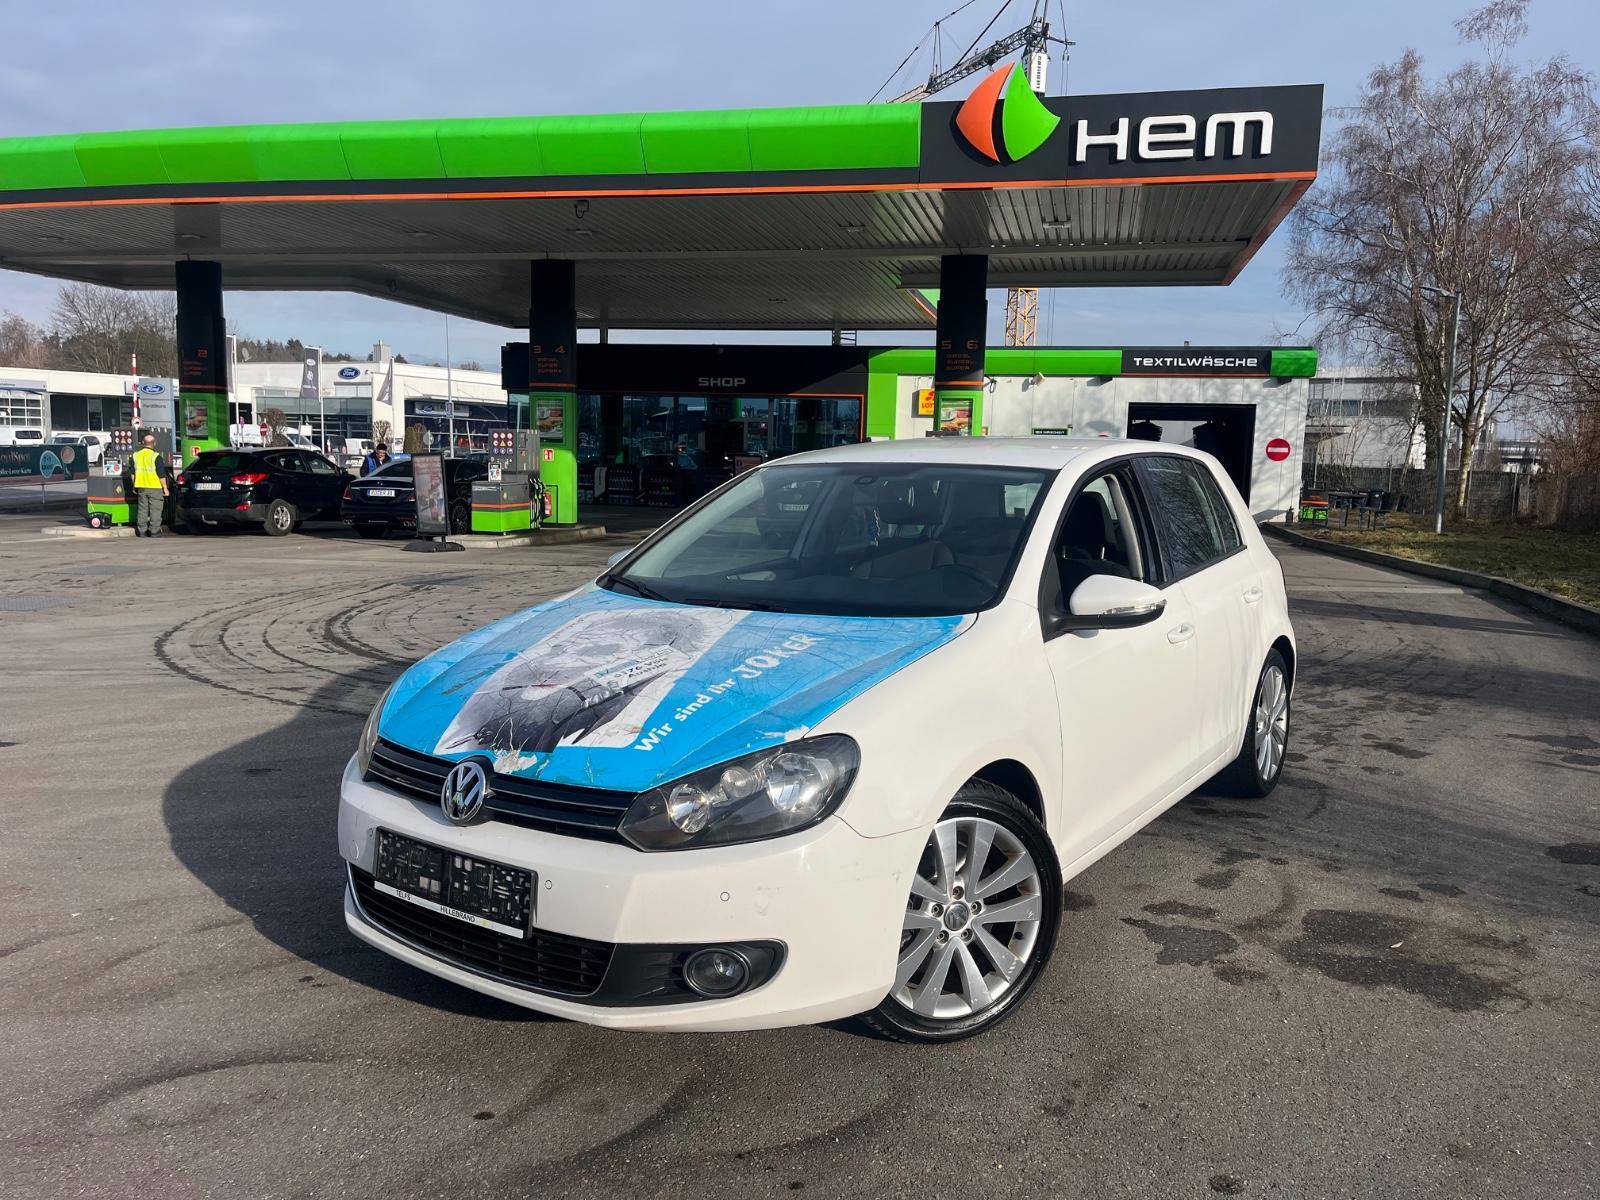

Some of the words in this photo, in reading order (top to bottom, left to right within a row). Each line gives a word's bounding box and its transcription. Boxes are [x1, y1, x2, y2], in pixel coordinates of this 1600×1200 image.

[533, 345, 541, 353] 3
[555, 345, 566, 353] 4
[1133, 355, 1258, 367] TEXTILWÄSCHE
[698, 377, 746, 387] SHOP
[634, 722, 672, 751] Wir
[674, 693, 713, 722] sind
[708, 678, 736, 695] Ihr
[731, 633, 825, 679] JOKER
[396, 889, 411, 901] TELFS
[440, 905, 476, 923] HILLEBRAND
